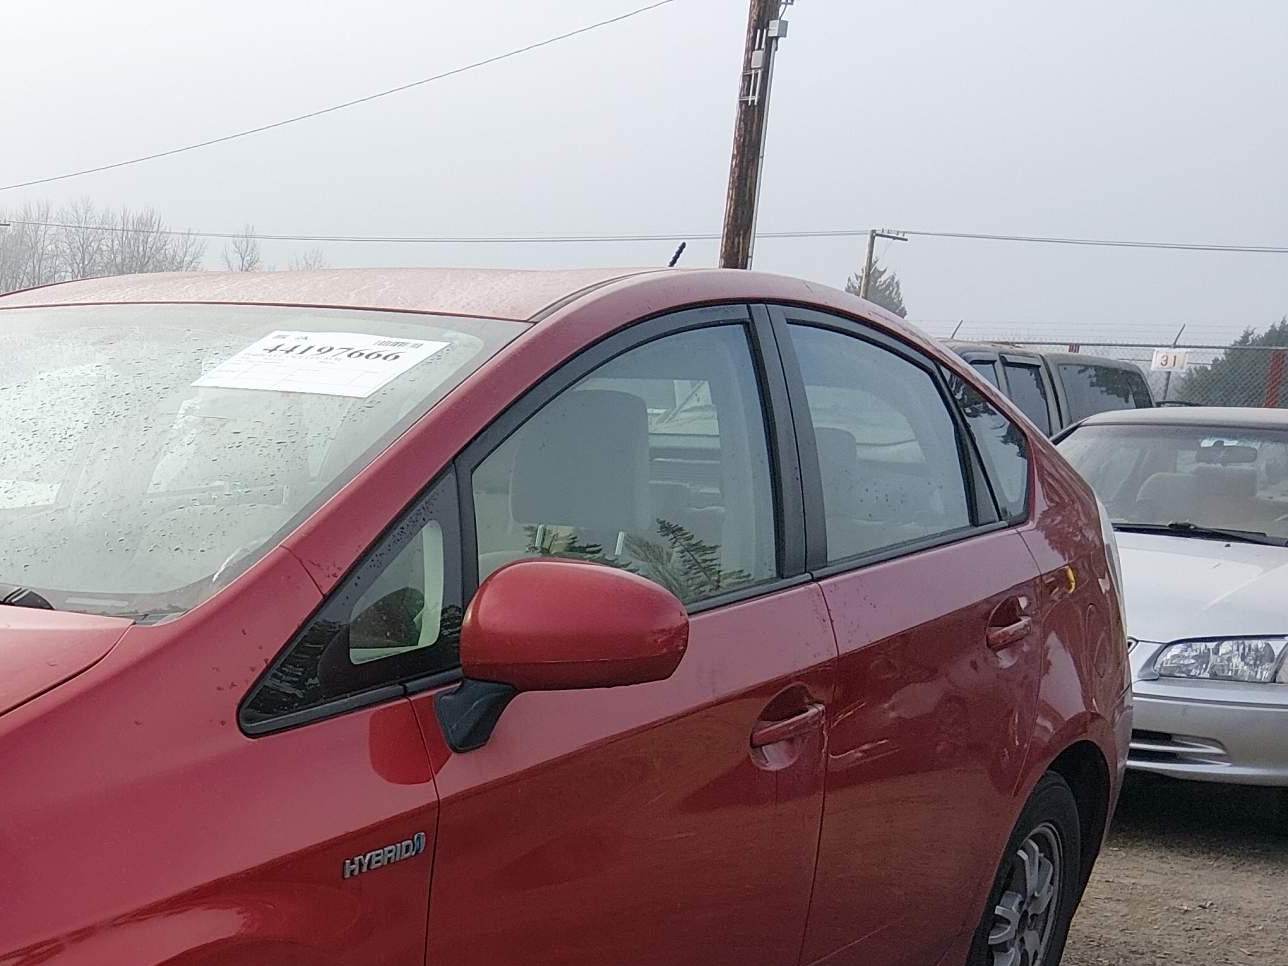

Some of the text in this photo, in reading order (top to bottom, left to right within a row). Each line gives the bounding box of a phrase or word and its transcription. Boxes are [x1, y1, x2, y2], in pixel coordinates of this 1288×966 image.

[263, 343, 406, 361] 44197666
[1160, 355, 1177, 367] 31
[343, 839, 415, 879] HYBRID
